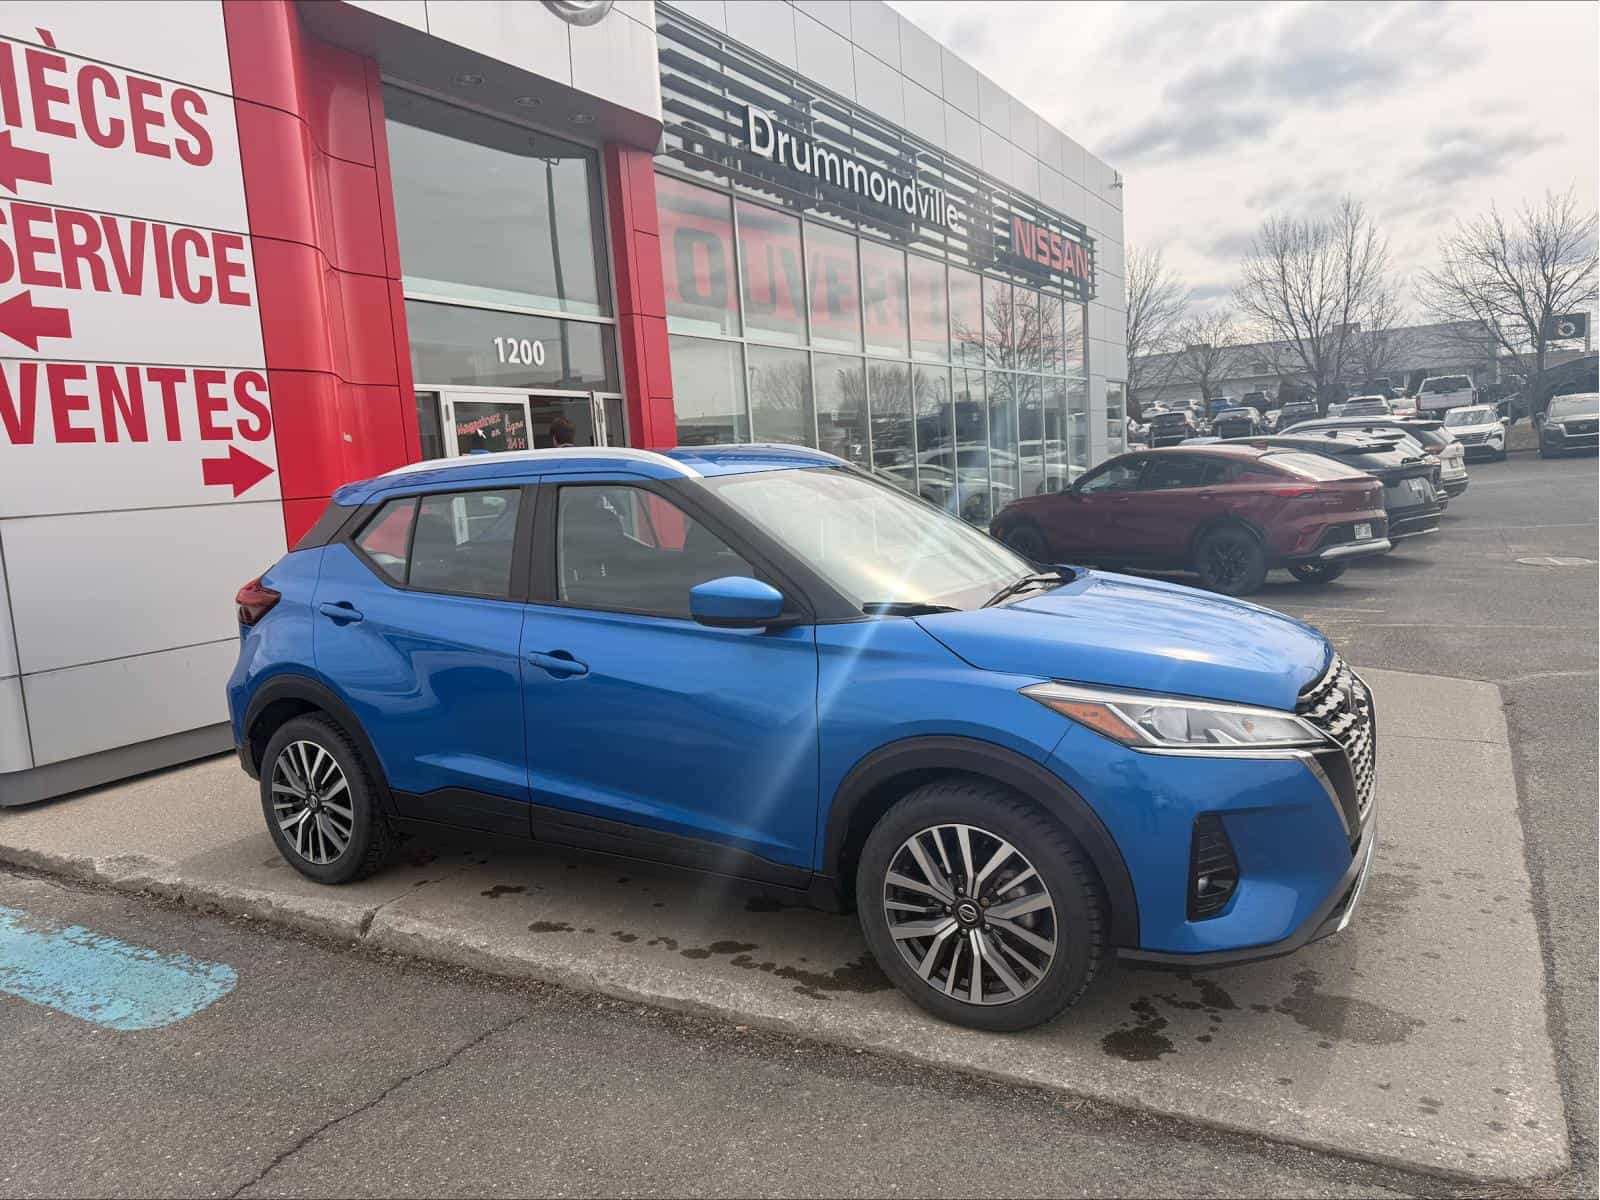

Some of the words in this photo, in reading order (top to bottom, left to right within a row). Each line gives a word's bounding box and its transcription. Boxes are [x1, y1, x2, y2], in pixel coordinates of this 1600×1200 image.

[748, 105, 960, 228] Drummondville
[1014, 216, 1089, 279] NISSAN
[493, 336, 545, 366] 1200
[0, 363, 272, 444] VENTES
